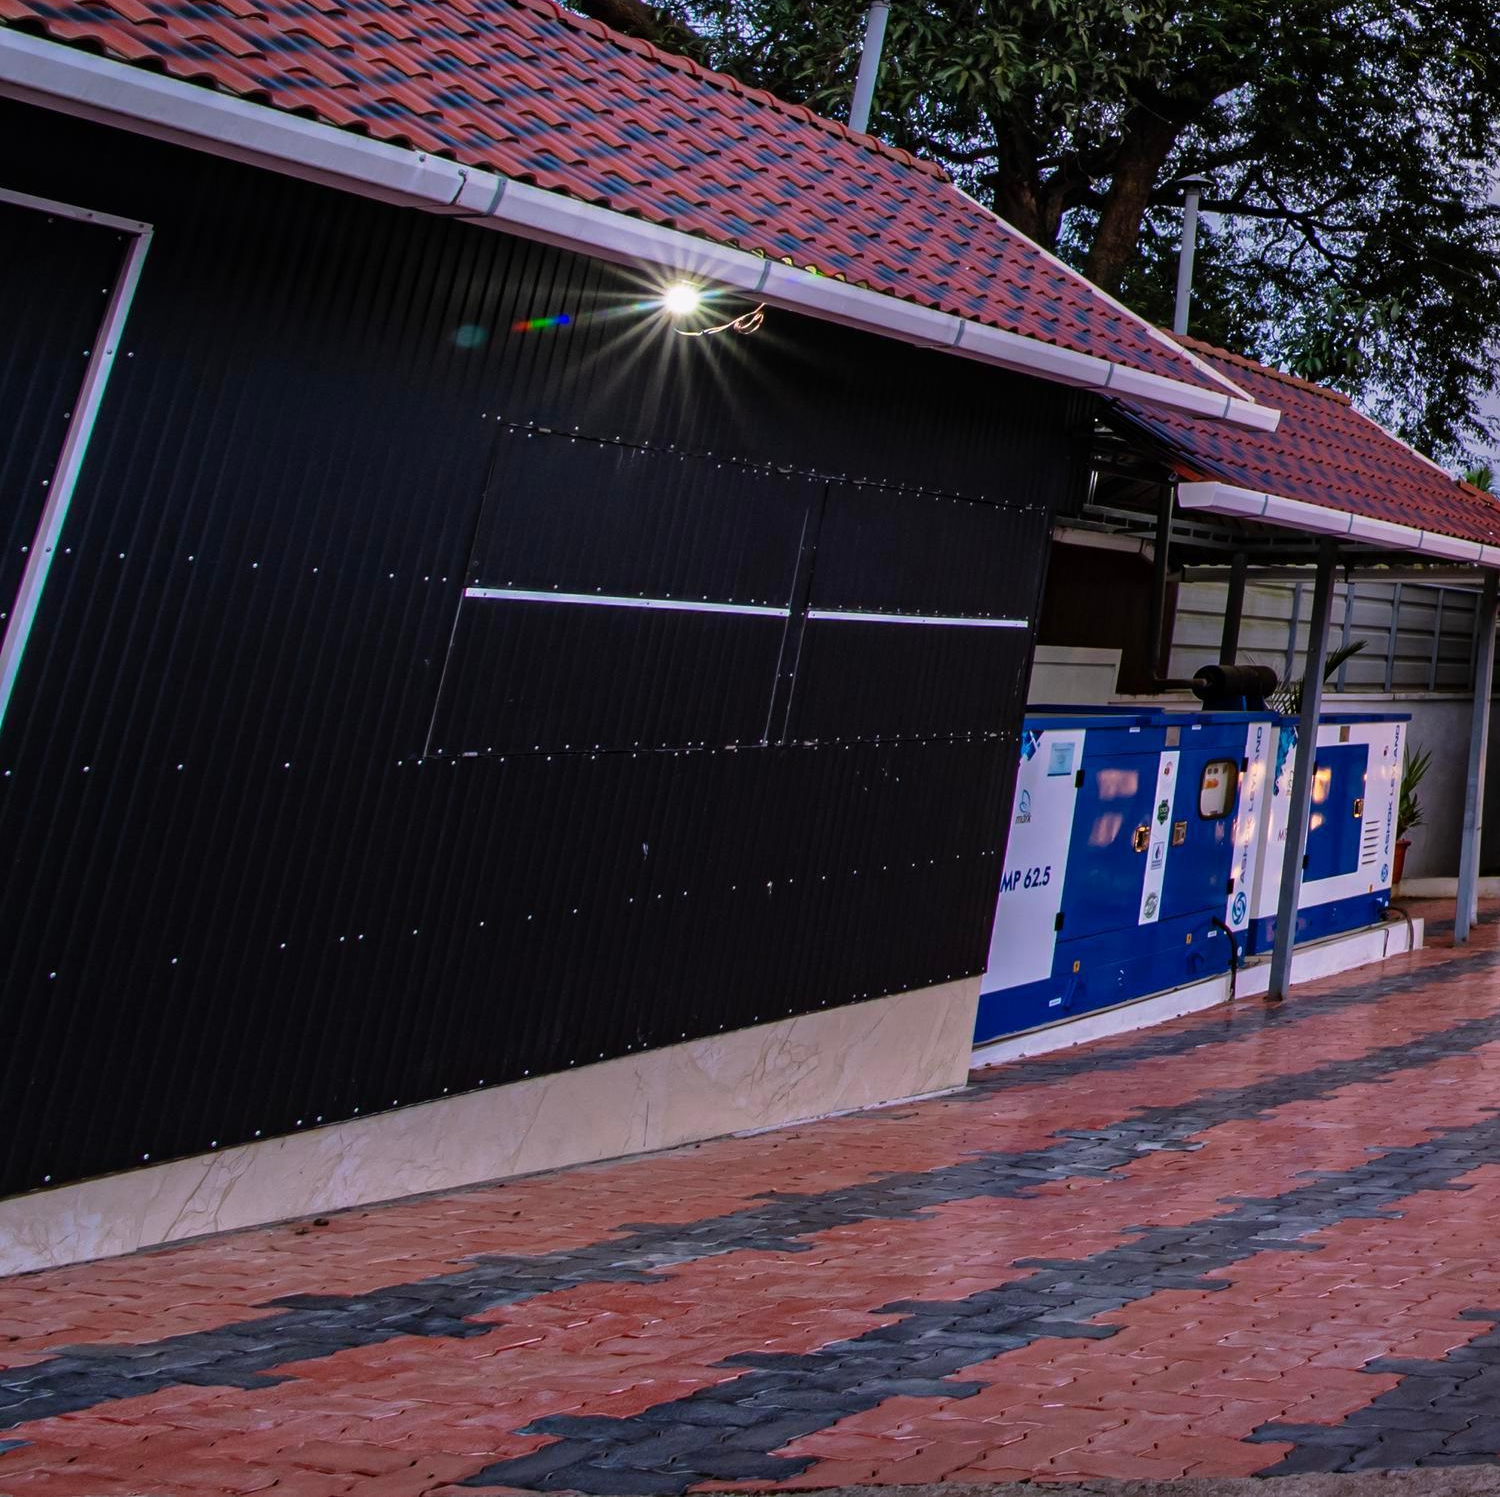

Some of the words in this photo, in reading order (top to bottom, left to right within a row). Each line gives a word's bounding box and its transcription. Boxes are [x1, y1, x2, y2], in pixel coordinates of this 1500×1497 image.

[1384, 801, 1393, 855] ASHOK
[1390, 725, 1400, 795] LEYLAND
[1023, 866, 1051, 889] 62.5
